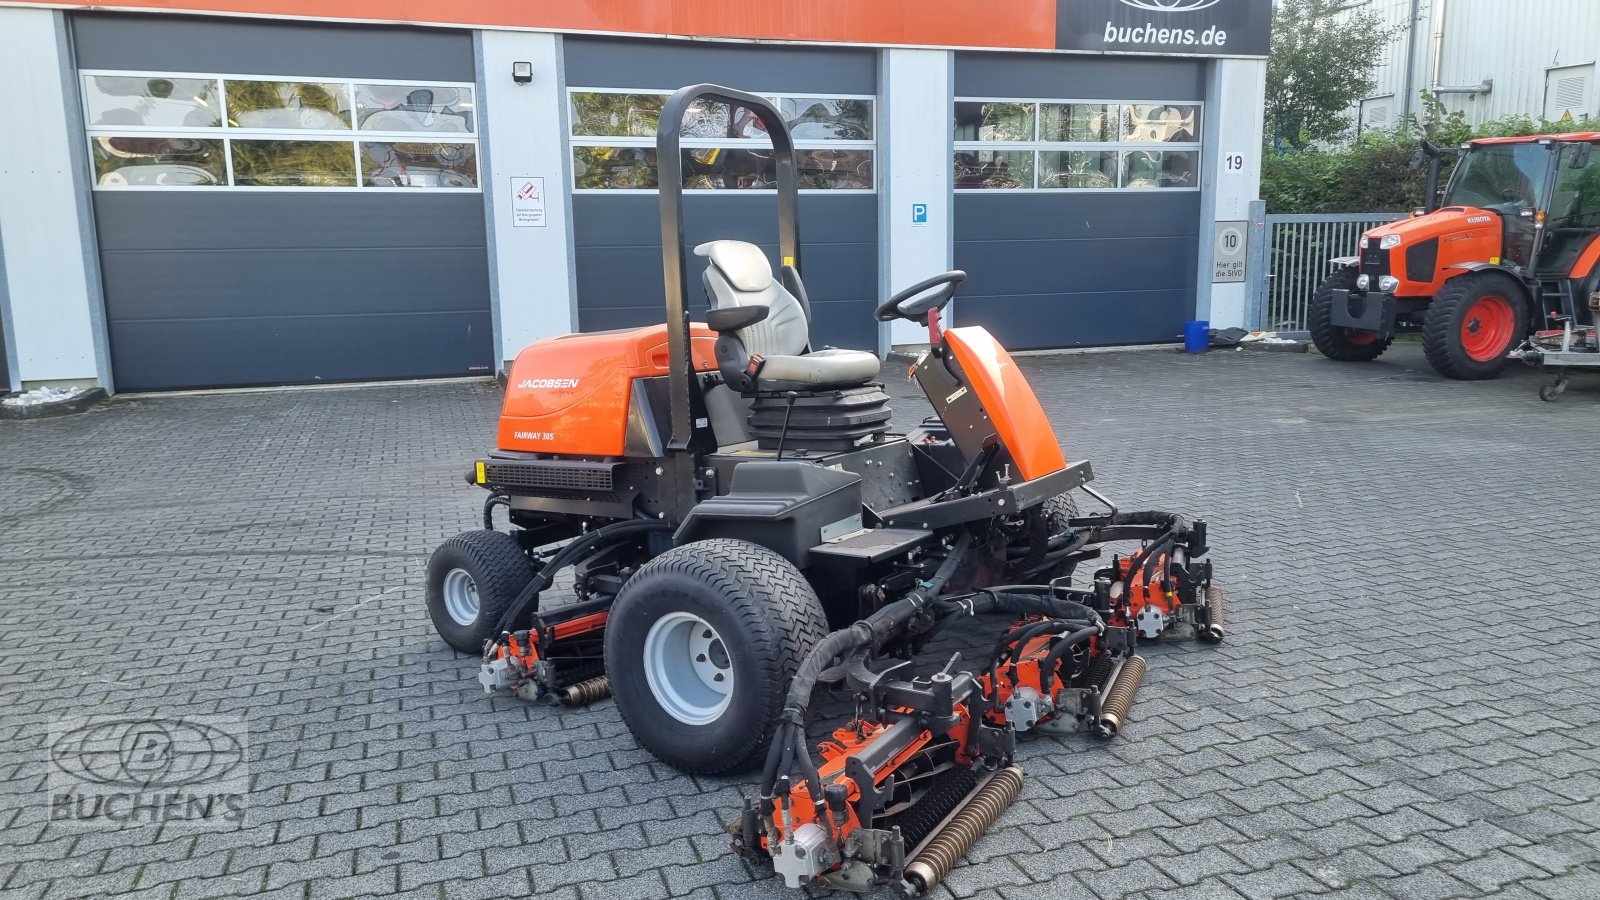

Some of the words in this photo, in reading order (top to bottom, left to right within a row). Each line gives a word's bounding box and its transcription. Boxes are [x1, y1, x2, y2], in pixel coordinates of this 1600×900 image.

[1103, 21, 1227, 46] buchens.de
[1226, 155, 1243, 170] 19
[914, 205, 925, 221] P
[1467, 215, 1491, 224] KUBOTA
[1224, 234, 1237, 248] 10
[1232, 260, 1243, 269] gilt
[1227, 269, 1243, 277] StVO
[518, 379, 579, 388] JACOBSEN
[514, 431, 541, 440] FAIRWAY
[542, 432, 554, 440] 305
